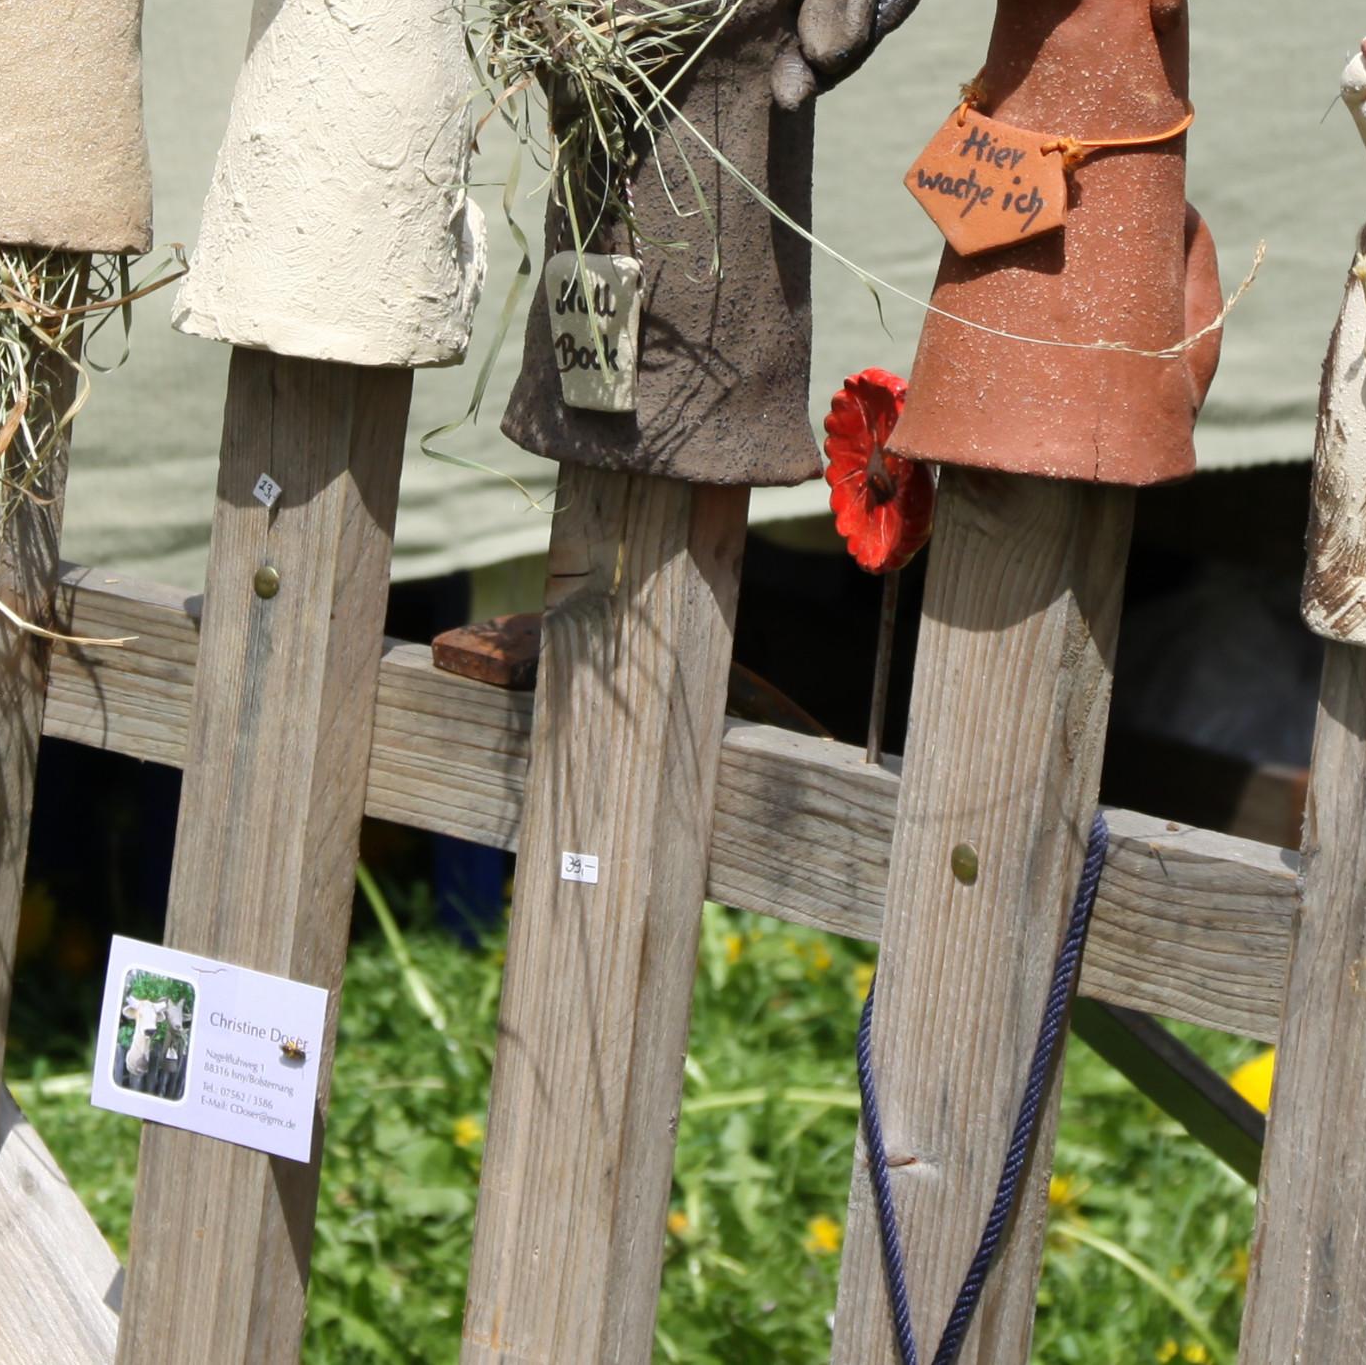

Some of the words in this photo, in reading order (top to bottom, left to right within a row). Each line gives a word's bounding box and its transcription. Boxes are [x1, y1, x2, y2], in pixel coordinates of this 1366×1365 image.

[960, 127, 1026, 170] Hier
[917, 168, 994, 218] wache
[1002, 175, 1043, 232] ich
[210, 1012, 266, 1038] Christine
[270, 1028, 308, 1050] Doser
[204, 1063, 229, 1076] 88316
[201, 1095, 228, 1110] E-Mail:
[230, 1103, 296, 1130] CDoser@gmx.de
[220, 1087, 245, 1102] 07562
[254, 1096, 273, 1109] 3586
